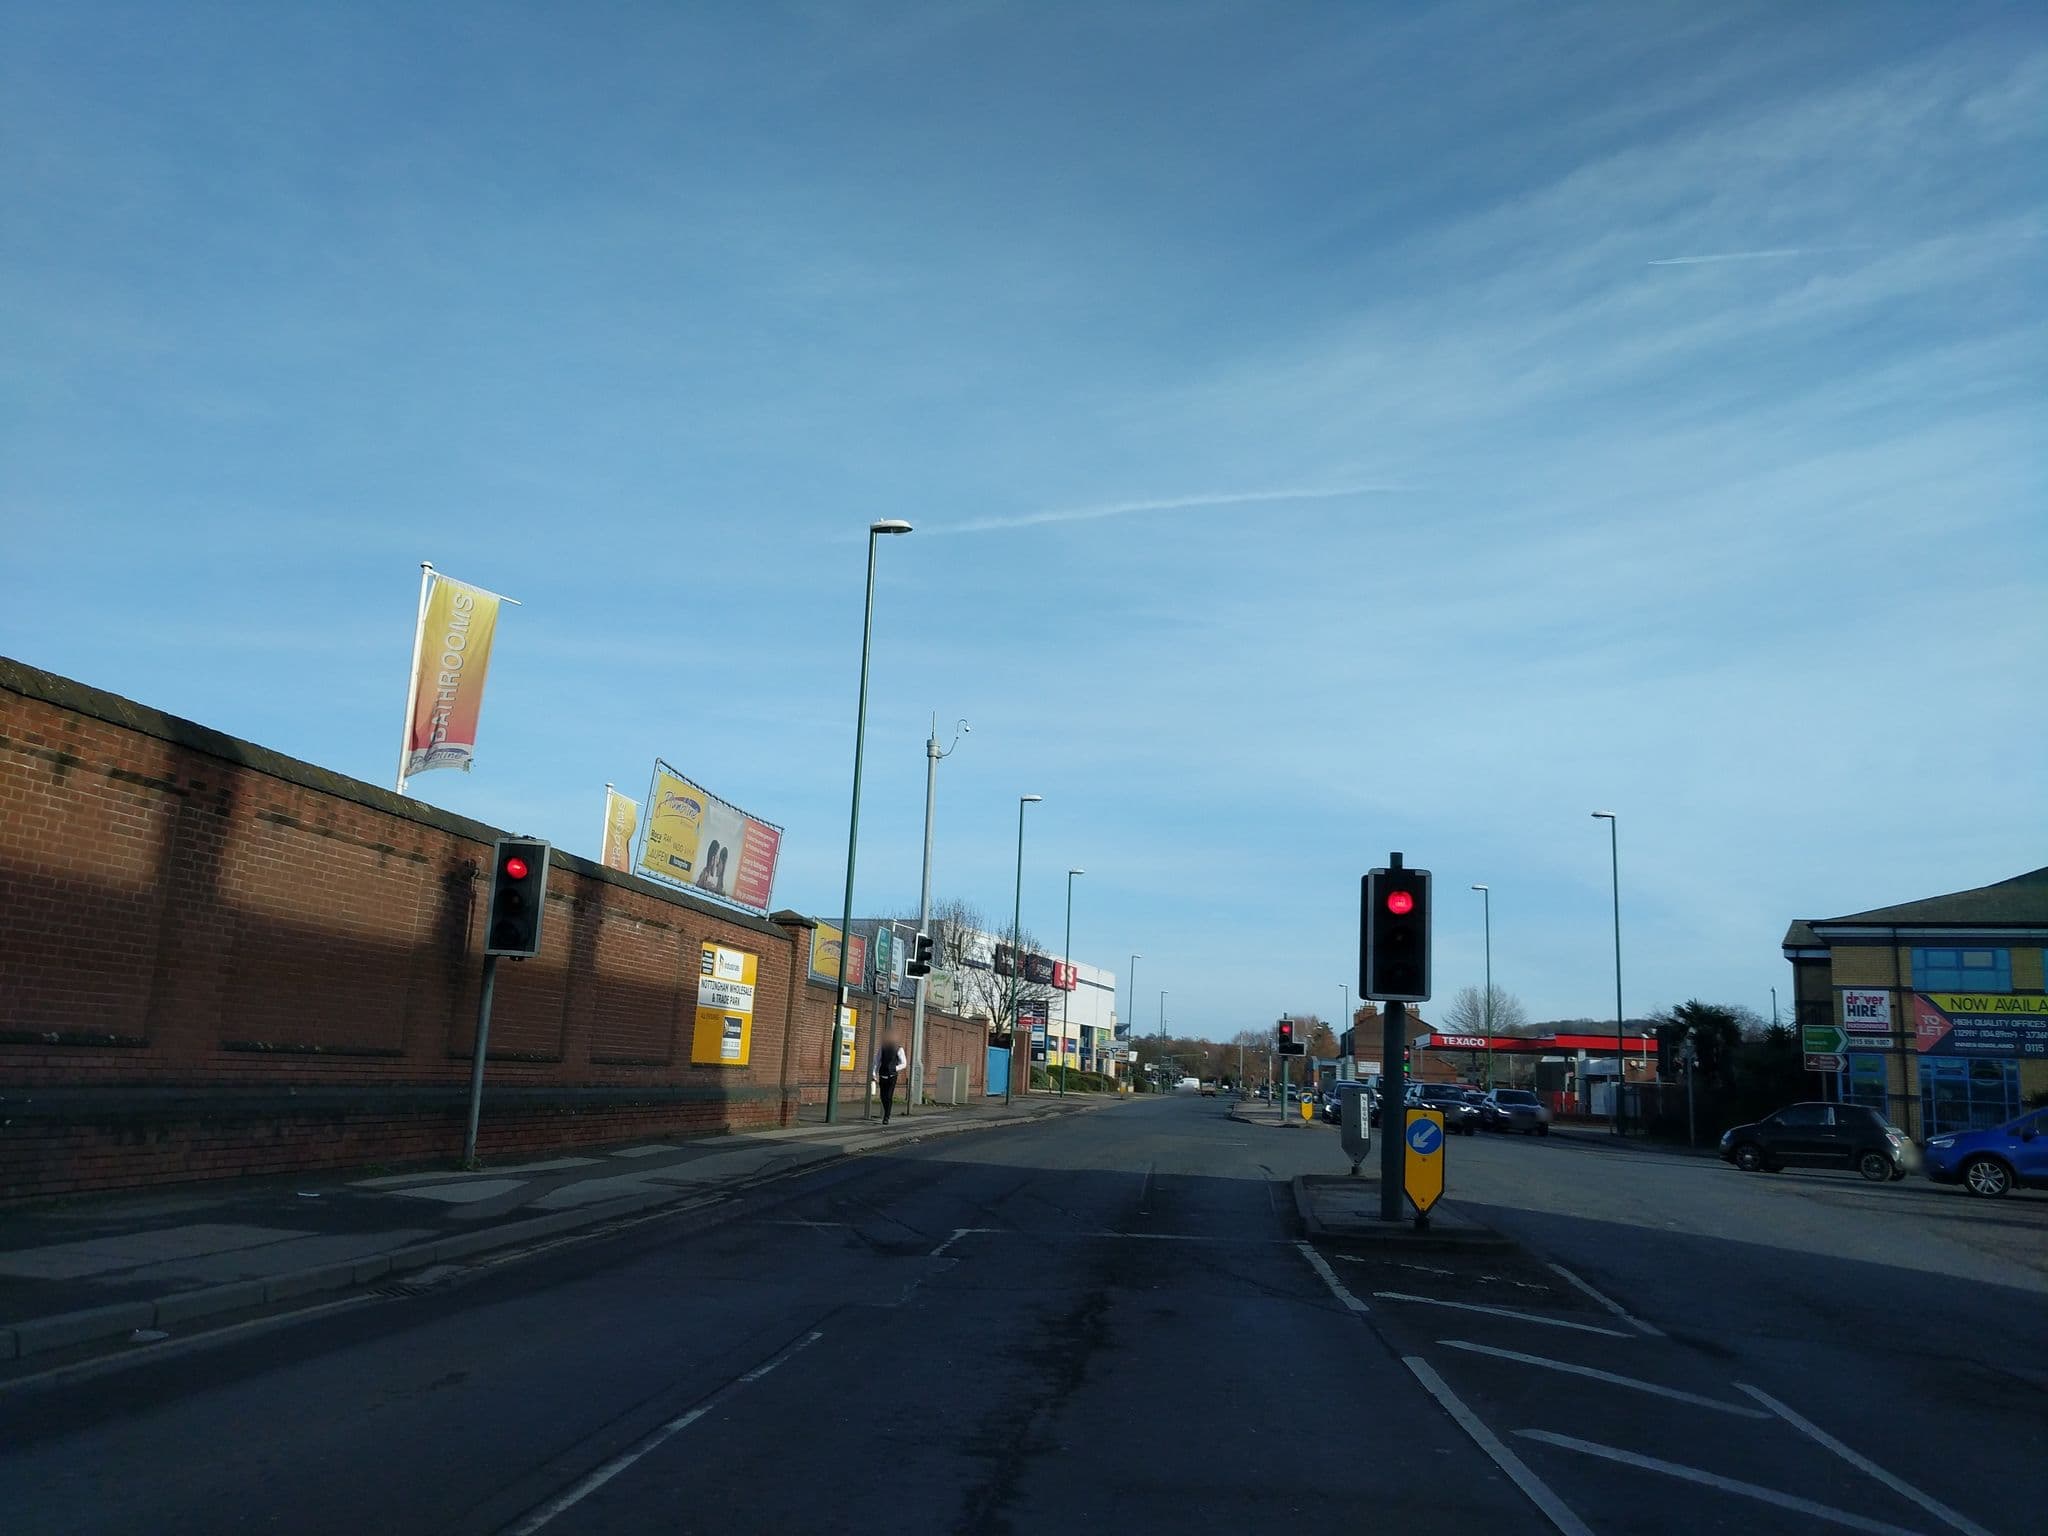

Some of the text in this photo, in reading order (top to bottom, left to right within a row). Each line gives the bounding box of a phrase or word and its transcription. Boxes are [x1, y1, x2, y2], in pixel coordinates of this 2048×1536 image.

[430, 592, 475, 743] BATHROOMS
[701, 979, 752, 996] NOTTINGHAM WHOLESALE
[716, 994, 729, 1005] TRADE
[730, 996, 740, 1006] PARK
[1846, 992, 1884, 1005] driver
[1848, 1005, 1877, 1017] HIRE
[1950, 998, 2048, 1012] NOW AVAILA
[1921, 1014, 1940, 1025] TO
[1953, 1018, 2046, 1028] HIGH QUALITY OFFICES
[1919, 1025, 1943, 1036] LET
[1441, 1036, 1486, 1047] TEXACO
[2025, 1043, 2045, 1053] 0115
